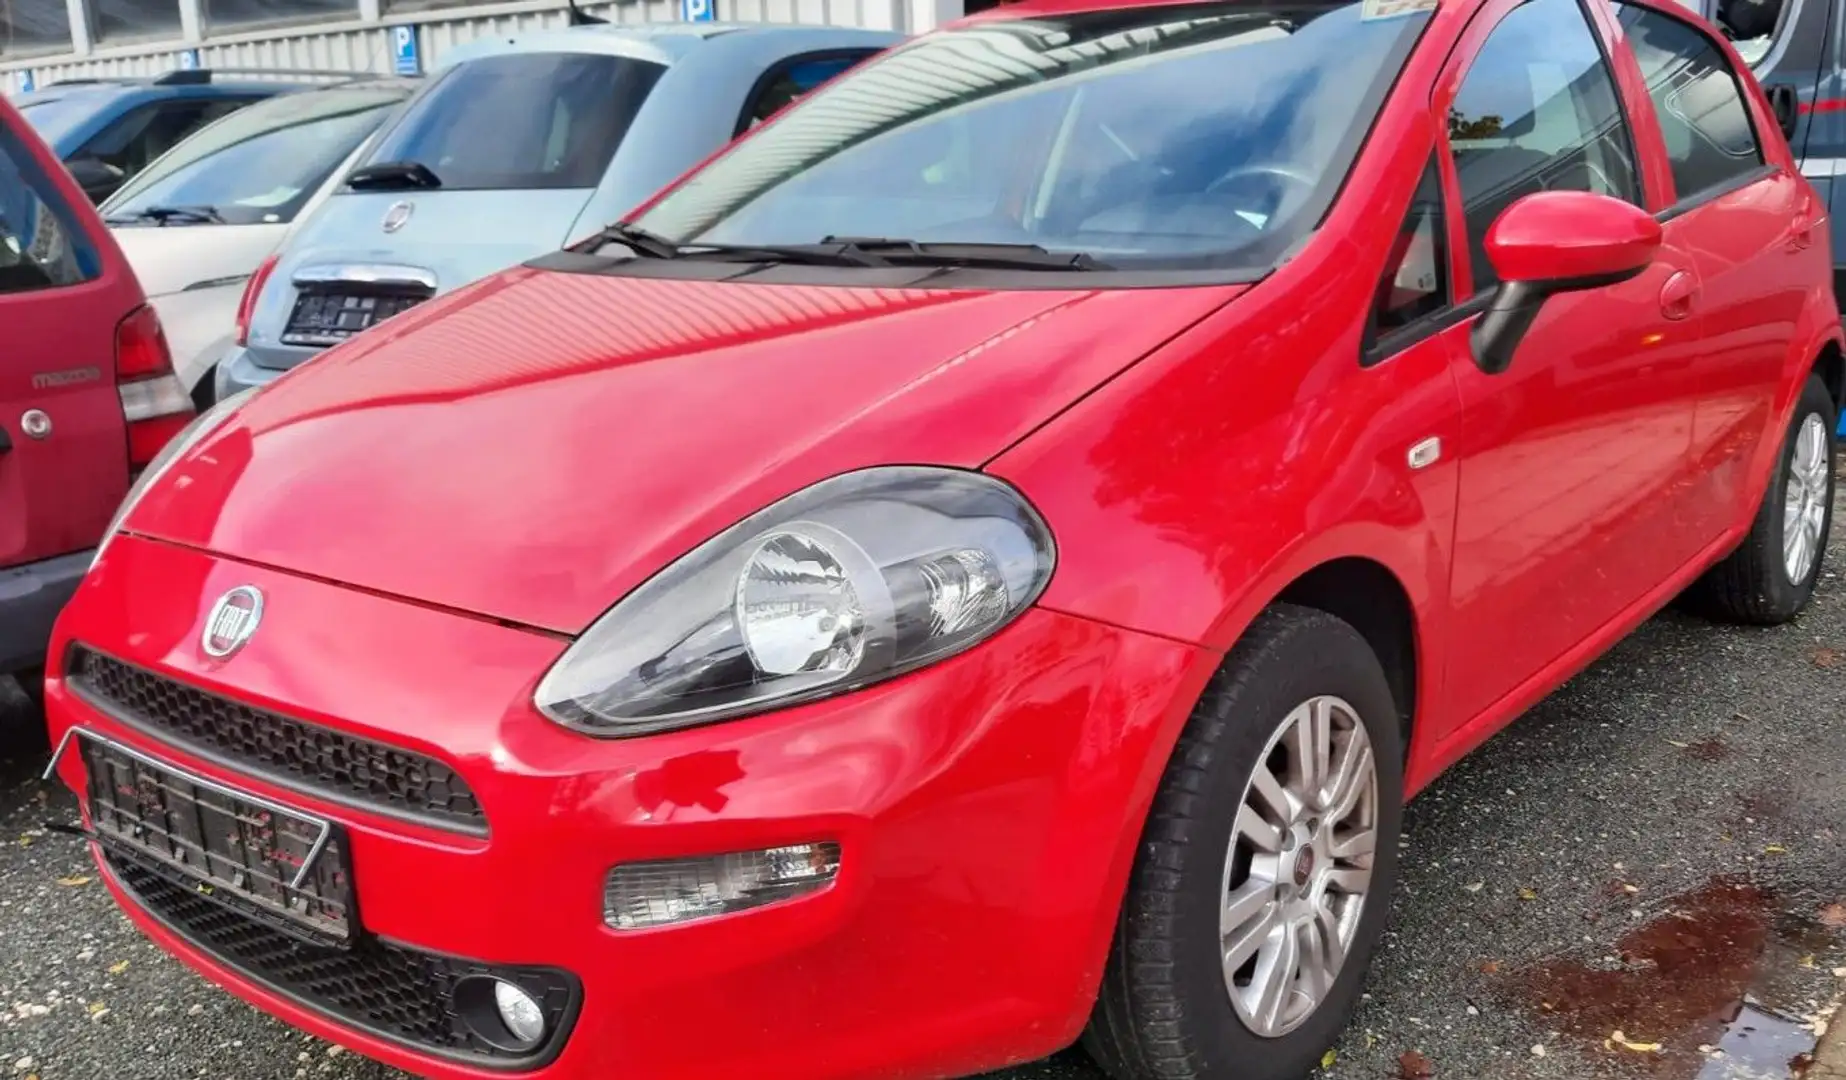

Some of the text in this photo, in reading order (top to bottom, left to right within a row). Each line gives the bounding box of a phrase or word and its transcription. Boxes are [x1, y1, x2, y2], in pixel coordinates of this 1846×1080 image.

[687, 0, 705, 22] P
[396, 26, 410, 57] P
[210, 603, 252, 641] FIAT
